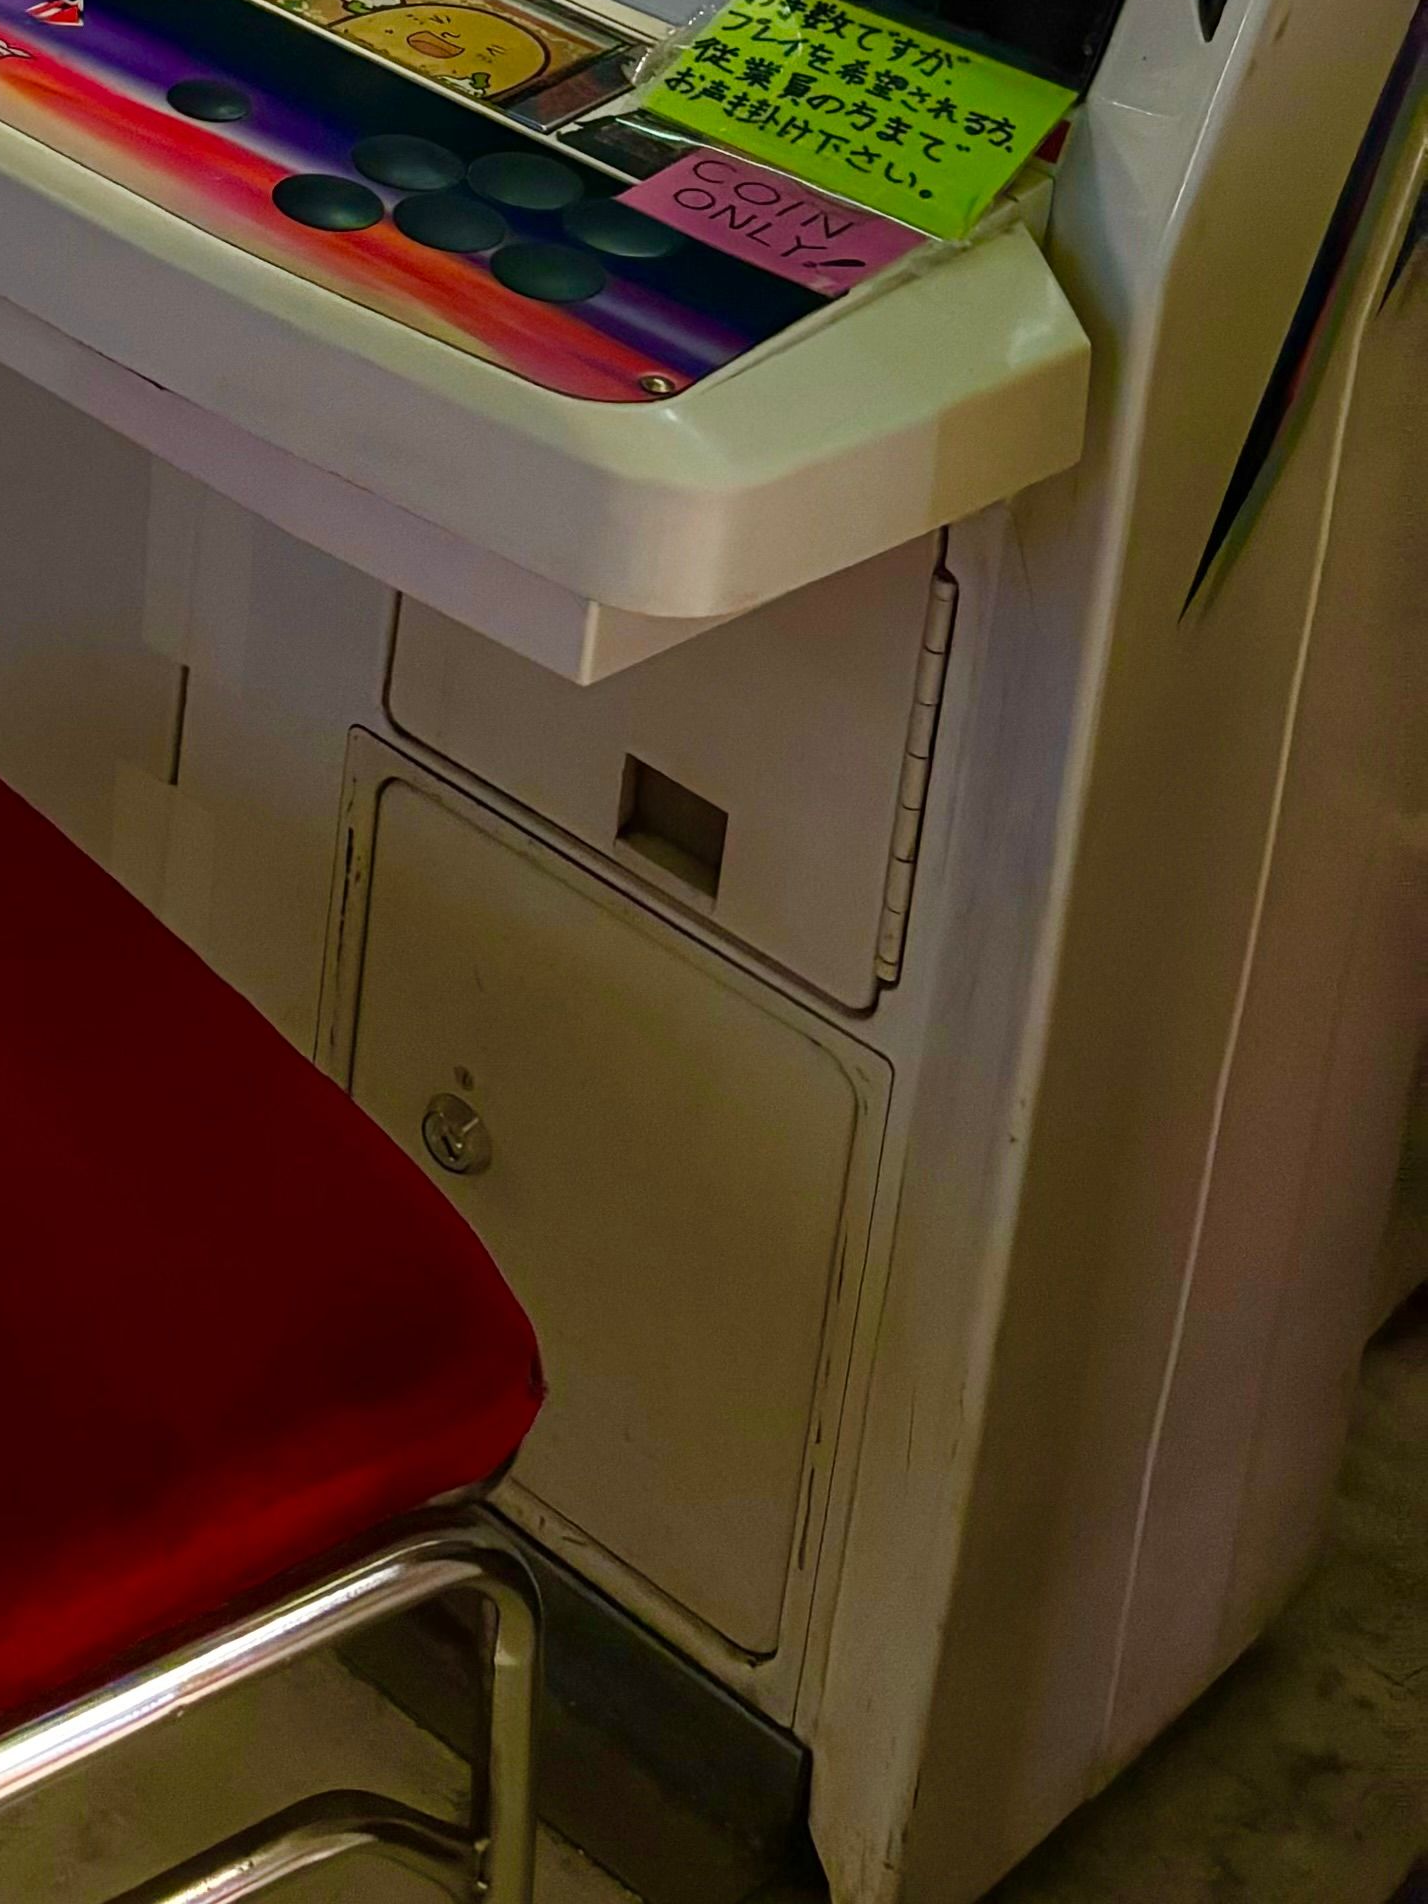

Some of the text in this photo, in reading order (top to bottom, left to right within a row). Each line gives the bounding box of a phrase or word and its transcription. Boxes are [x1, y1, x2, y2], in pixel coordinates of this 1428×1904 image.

[664, 69, 935, 200] お声掛け下さい。
[692, 35, 971, 164] 従業員の方まで
[672, 187, 867, 270] ONLY!
[692, 159, 852, 239] COIN
